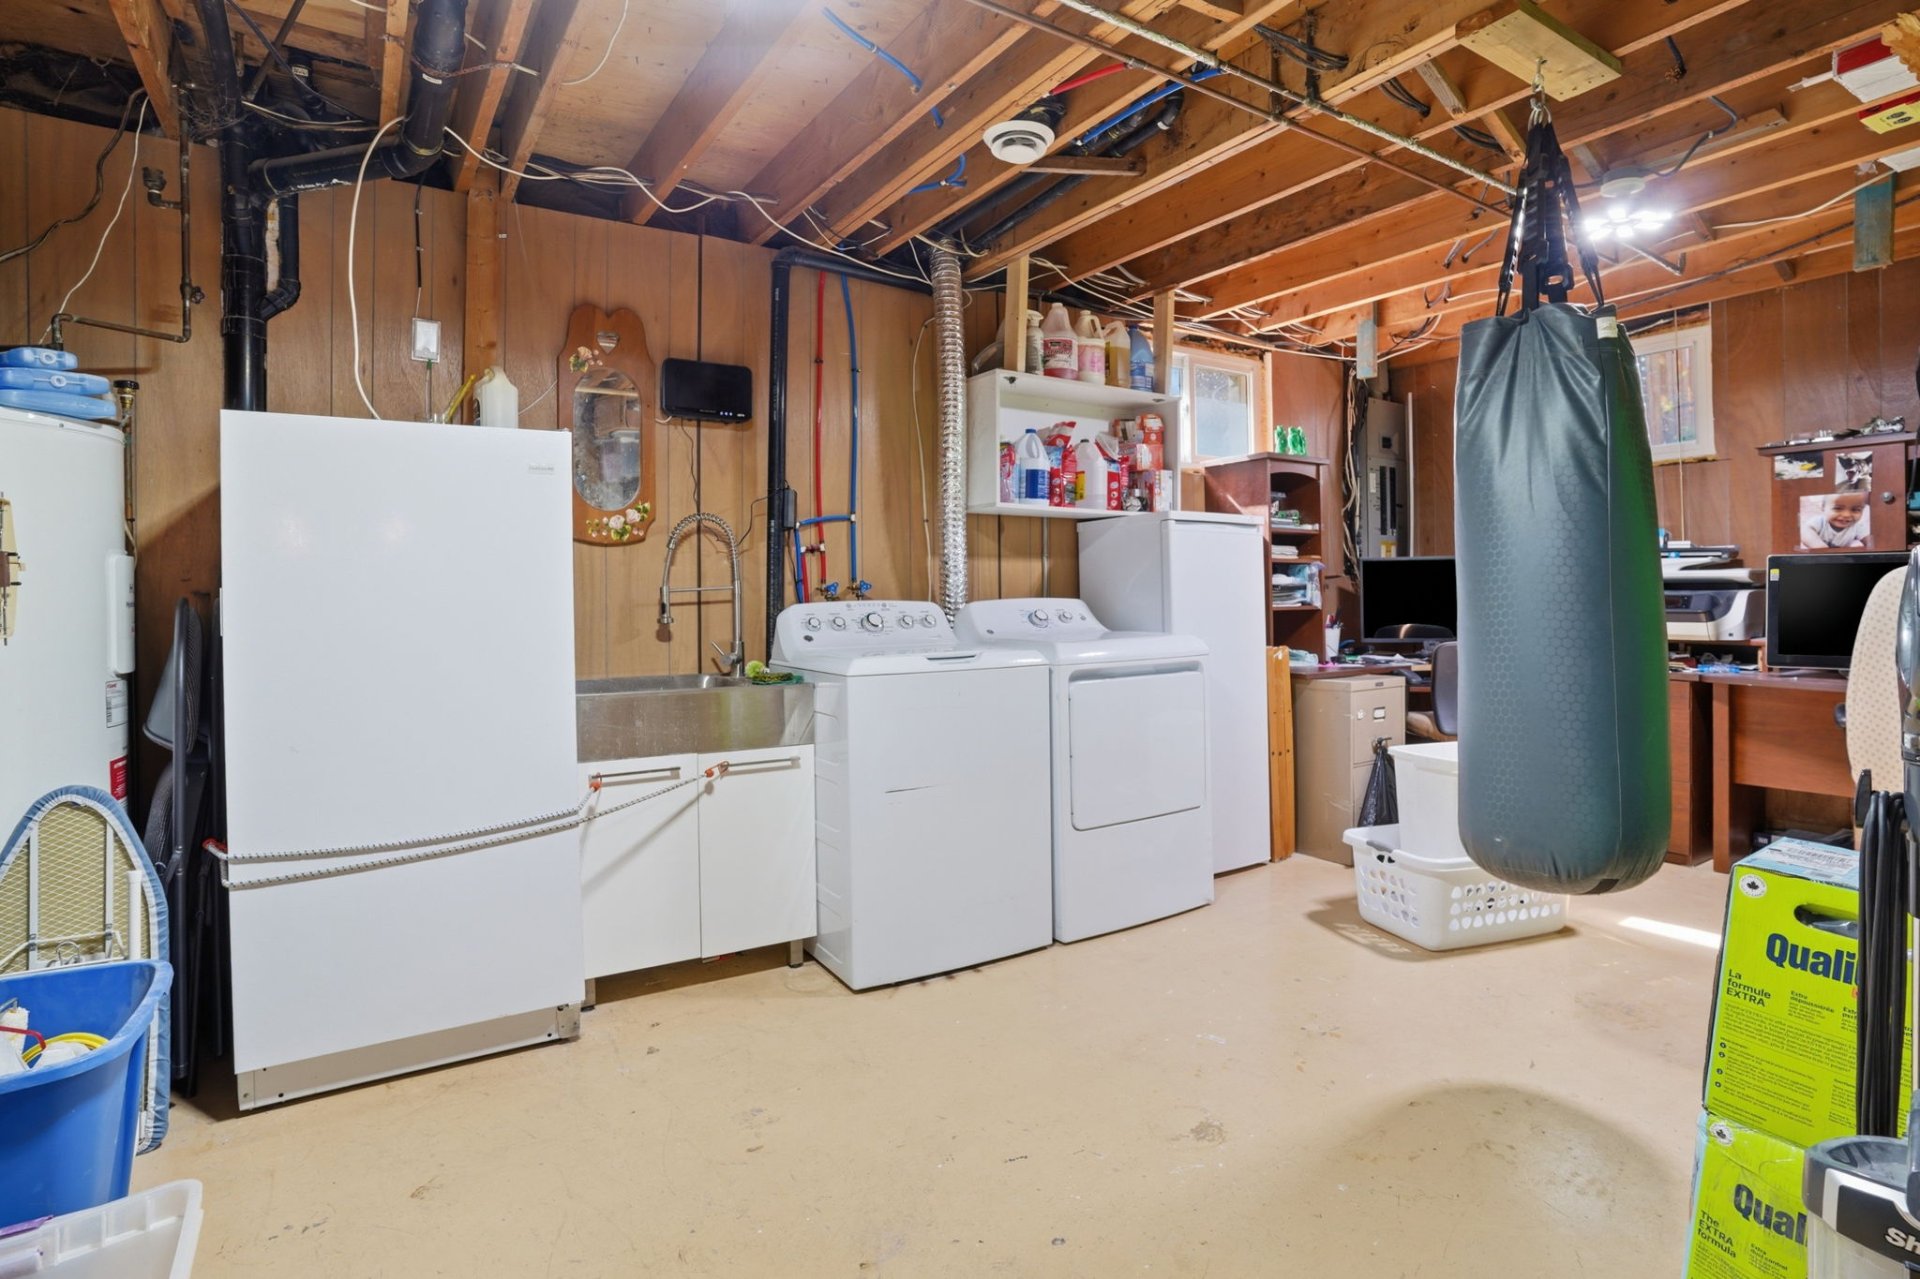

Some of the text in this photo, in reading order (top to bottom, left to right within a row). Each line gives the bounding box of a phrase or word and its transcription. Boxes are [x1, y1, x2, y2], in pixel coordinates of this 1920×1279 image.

[1766, 933, 1858, 985] Quali
[1728, 969, 1742, 980] La
[1726, 986, 1765, 1007] EXTRA
[1727, 978, 1771, 999] formule
[1700, 1210, 1720, 1227] The
[1734, 1184, 1808, 1246] Qual
[1697, 1228, 1737, 1259] formula
[1698, 1220, 1734, 1246] EXTRA
